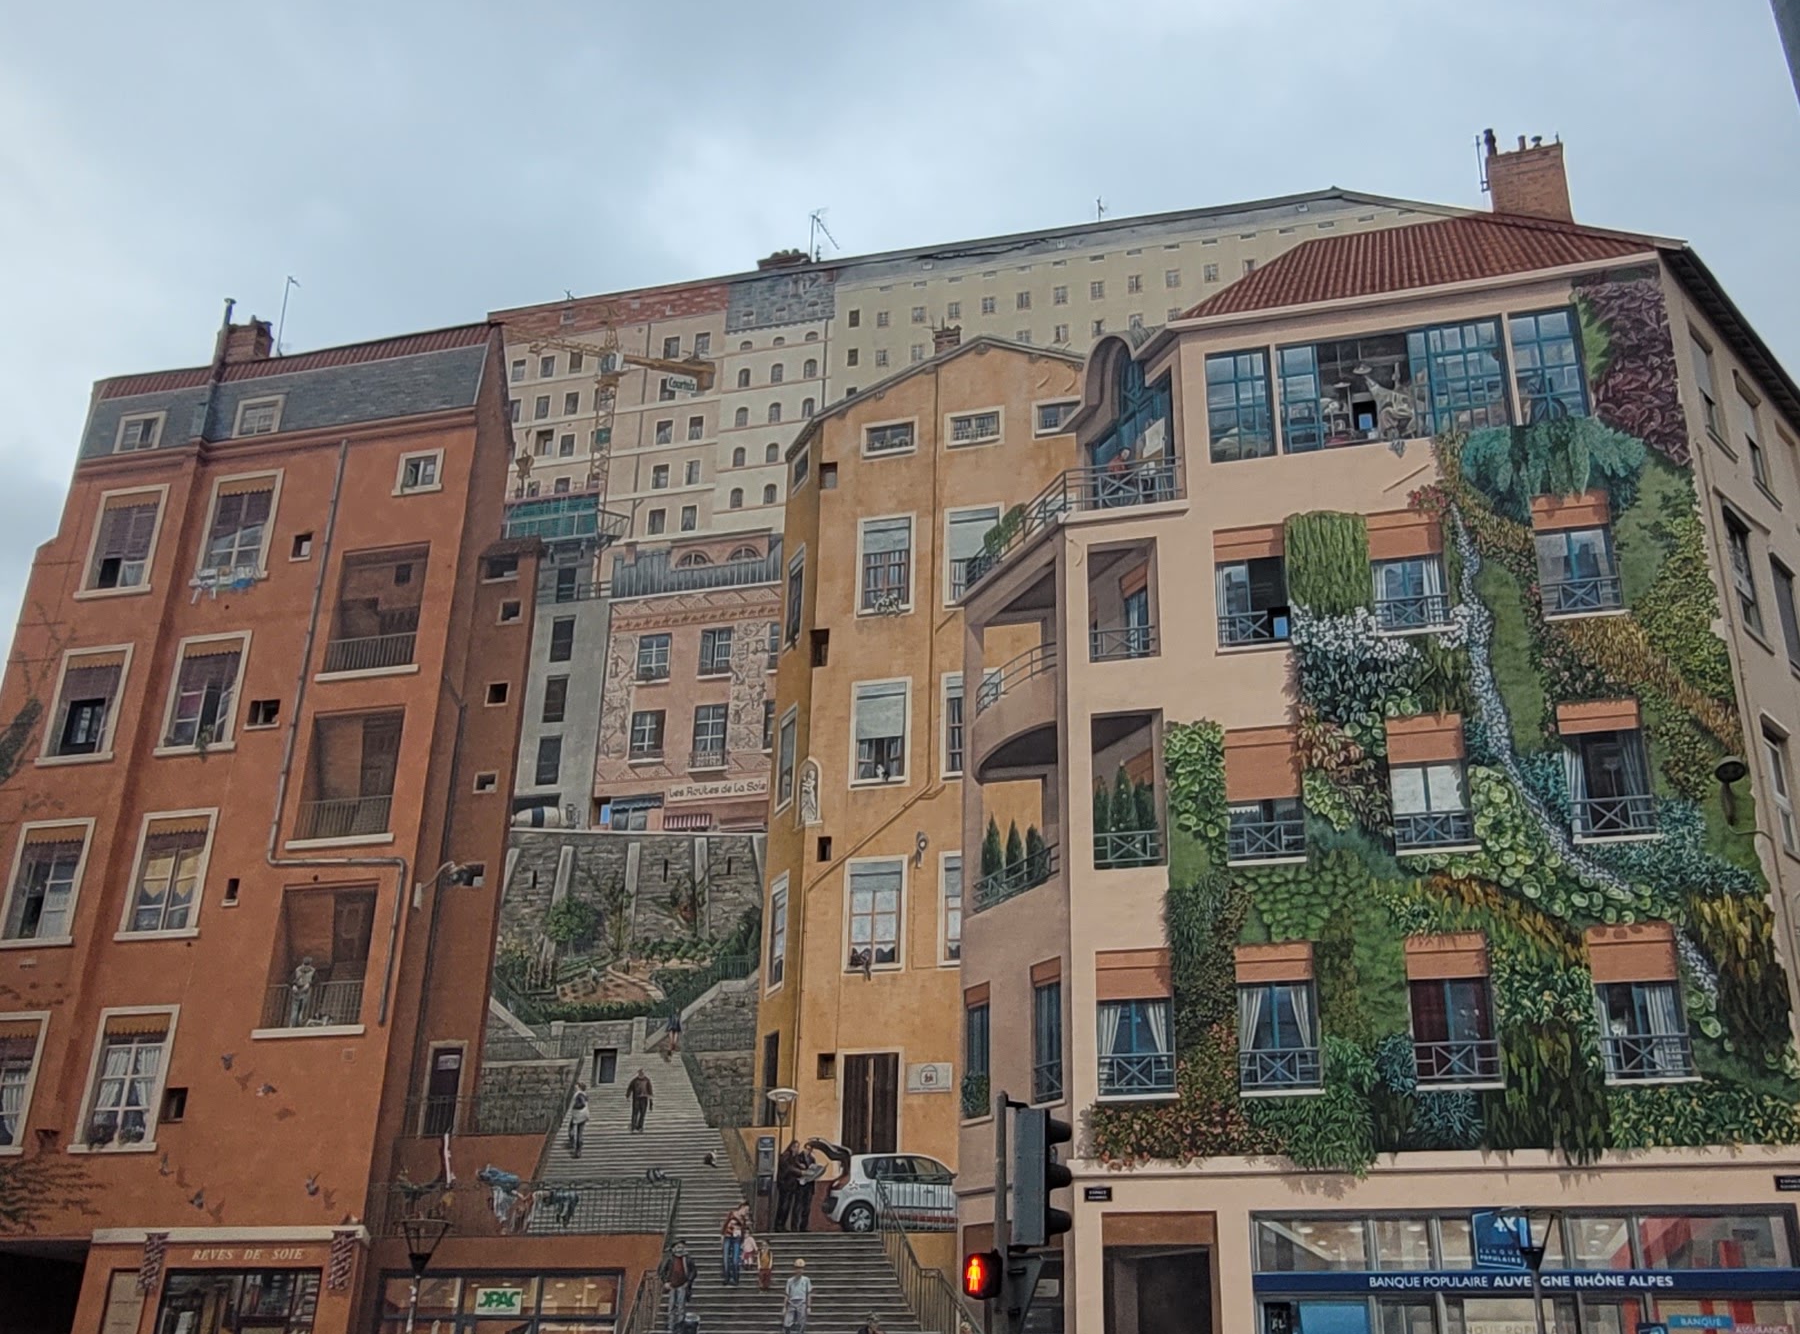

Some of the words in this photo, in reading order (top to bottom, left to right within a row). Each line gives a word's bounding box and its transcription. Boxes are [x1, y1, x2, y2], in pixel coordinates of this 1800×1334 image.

[720, 783, 731, 794] de
[746, 780, 767, 792] Soie
[243, 1249, 263, 1260] DE
[271, 1248, 304, 1260] SOIE
[1369, 1276, 1421, 1289] BANQUE
[1423, 1276, 1489, 1288] POPULAIRE
[1493, 1275, 1571, 1288] AUVEGNE
[1574, 1272, 1626, 1288] RHÔNE
[1628, 1275, 1674, 1288] ALPES
[1681, 1317, 1722, 1328] BANQUE
